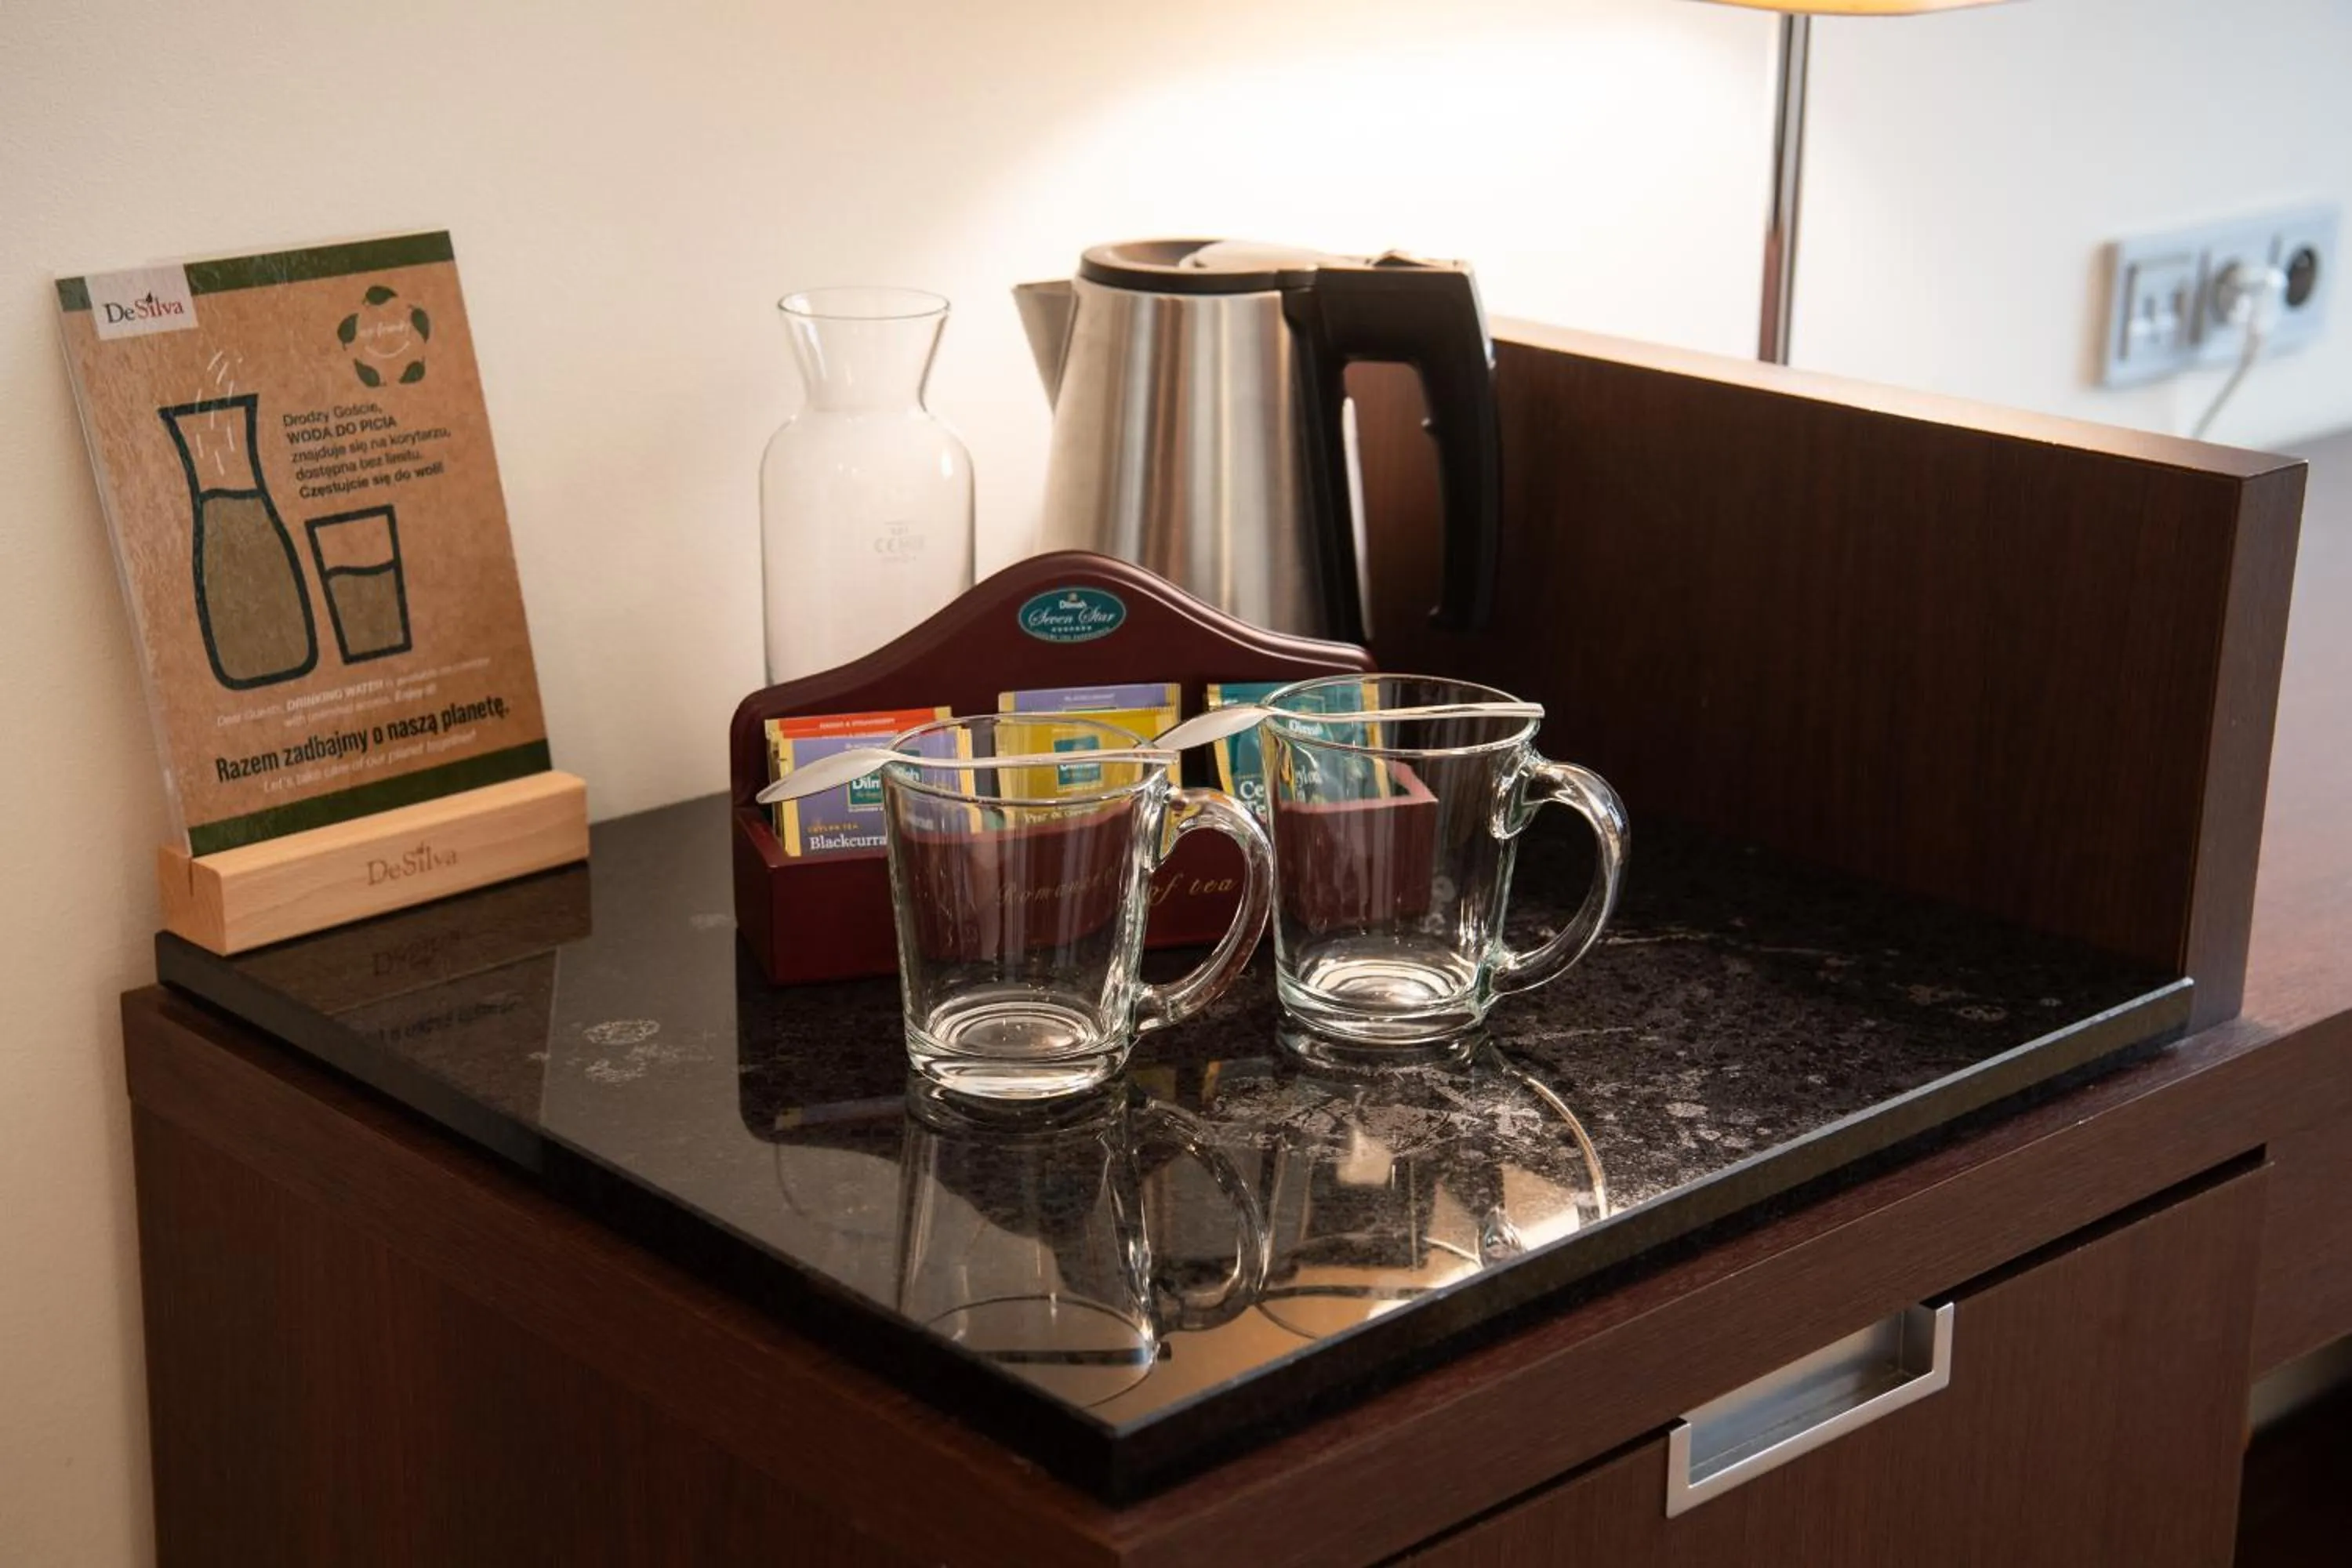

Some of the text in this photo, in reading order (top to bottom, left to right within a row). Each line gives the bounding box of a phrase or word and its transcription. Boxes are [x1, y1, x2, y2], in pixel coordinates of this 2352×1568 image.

[103, 291, 184, 323] DeSilva
[283, 402, 383, 427] Drodzy Goście,
[287, 416, 397, 445] WODA DO PICIA
[291, 444, 346, 463] znajduje
[349, 440, 368, 454] się
[371, 437, 387, 449] na
[296, 459, 357, 481] dostępna
[360, 455, 383, 469] bez
[299, 477, 368, 499] Częstujcie
[372, 473, 391, 487] się
[394, 468, 411, 482] do
[1028, 605, 1116, 626] Seven Star
[286, 688, 343, 712] DRINKING
[344, 679, 383, 697] WATER
[216, 695, 510, 783] Razem zadbajmy o naszą planetę.
[809, 833, 887, 850] Blackcurra
[367, 840, 458, 887] DeSilva
[1149, 873, 1184, 906] of
[1189, 877, 1237, 897] tea
